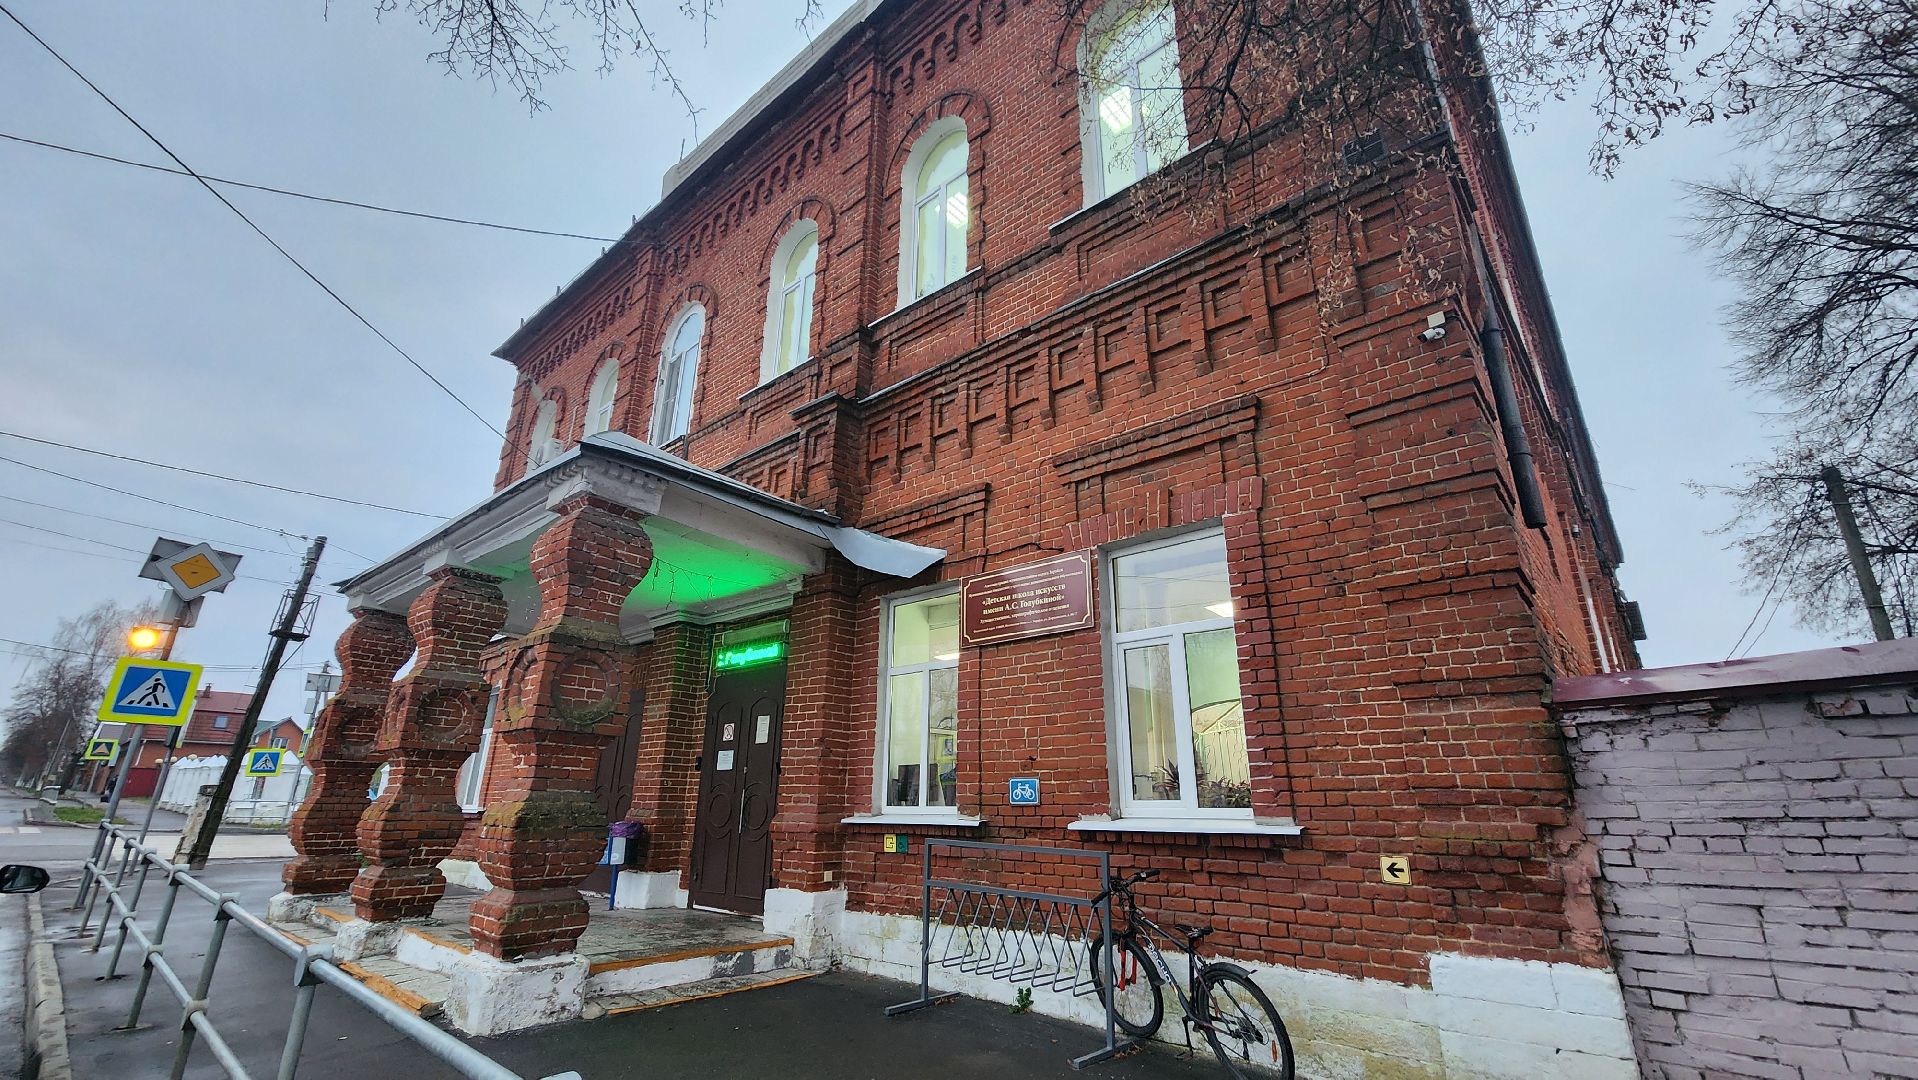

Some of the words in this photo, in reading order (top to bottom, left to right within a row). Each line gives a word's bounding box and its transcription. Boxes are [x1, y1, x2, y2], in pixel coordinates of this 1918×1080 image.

[982, 593, 1010, 605] «Детская
[1012, 589, 1033, 599] школа
[1035, 583, 1065, 595] искусств
[983, 605, 1003, 614] имени
[1004, 601, 1018, 610] А.С.
